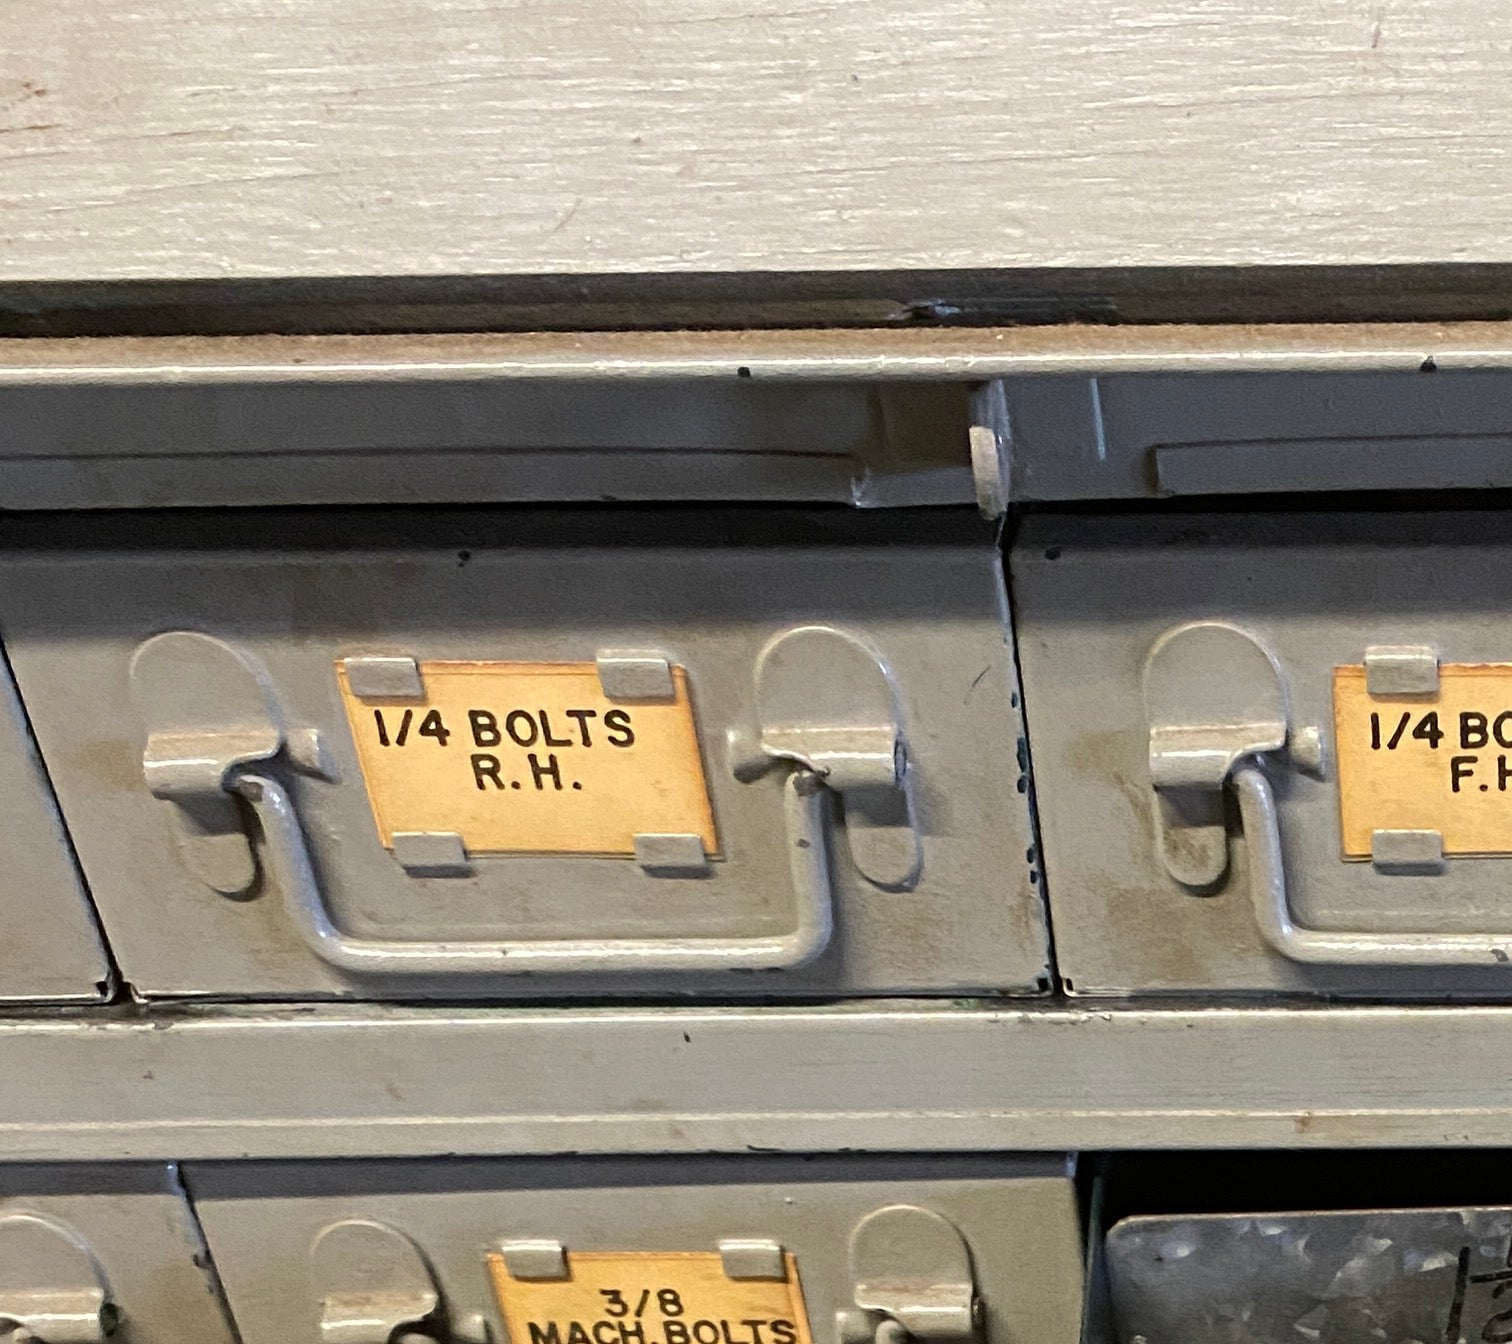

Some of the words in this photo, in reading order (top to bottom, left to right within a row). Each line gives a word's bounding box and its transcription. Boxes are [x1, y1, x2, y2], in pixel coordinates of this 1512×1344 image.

[374, 709, 451, 747] 1/4
[468, 709, 636, 748] BOLTS
[1370, 711, 1445, 749] 1/4
[470, 753, 584, 791] R.H.
[599, 1287, 685, 1319] 3/8
